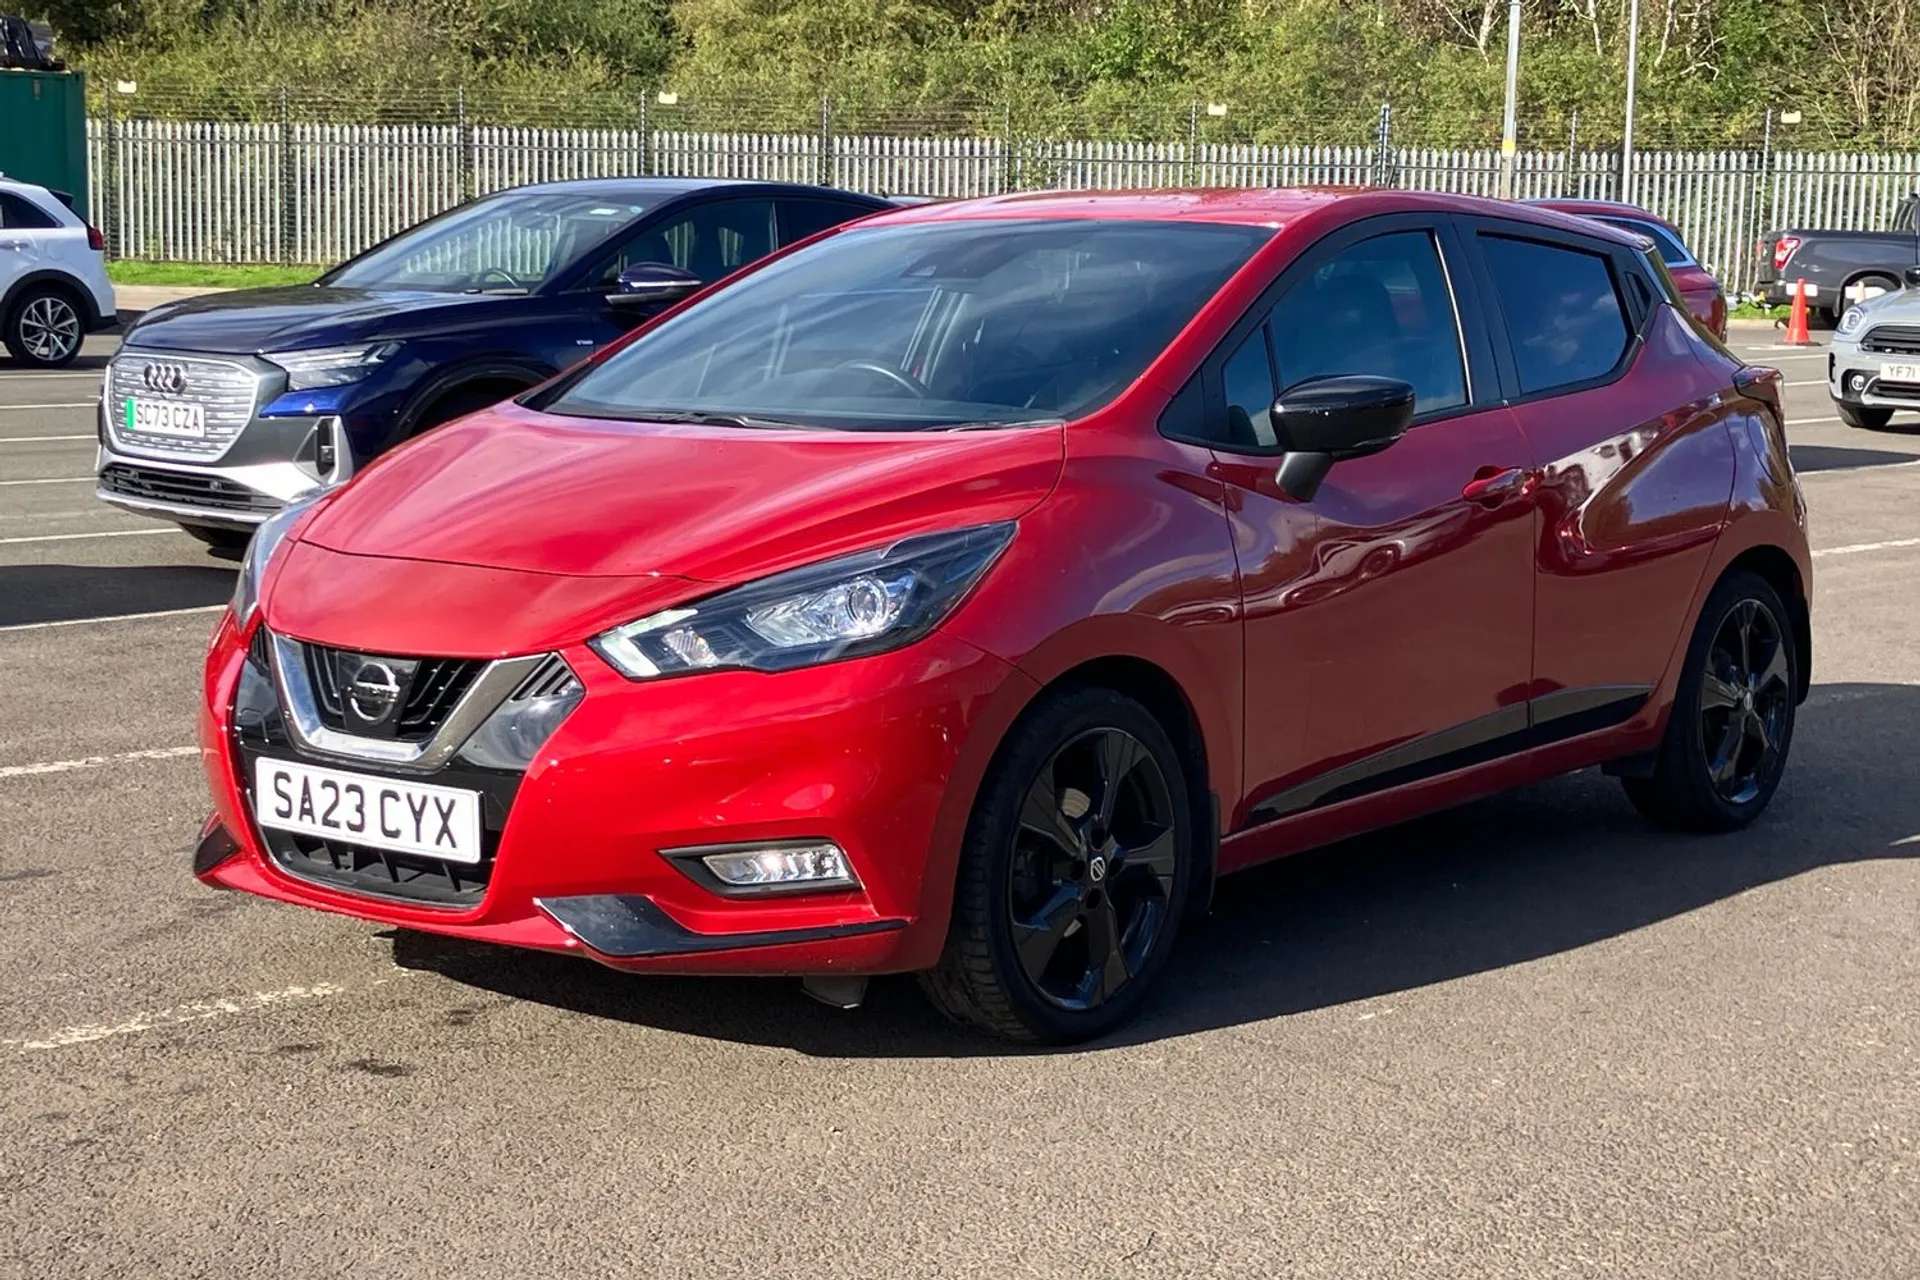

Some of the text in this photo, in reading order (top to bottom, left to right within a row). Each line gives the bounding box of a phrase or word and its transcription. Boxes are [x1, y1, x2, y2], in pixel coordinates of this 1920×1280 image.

[1888, 365, 1916, 378] YF71
[136, 403, 200, 431] SC73 CZA
[273, 771, 457, 848] SA23 CYX
